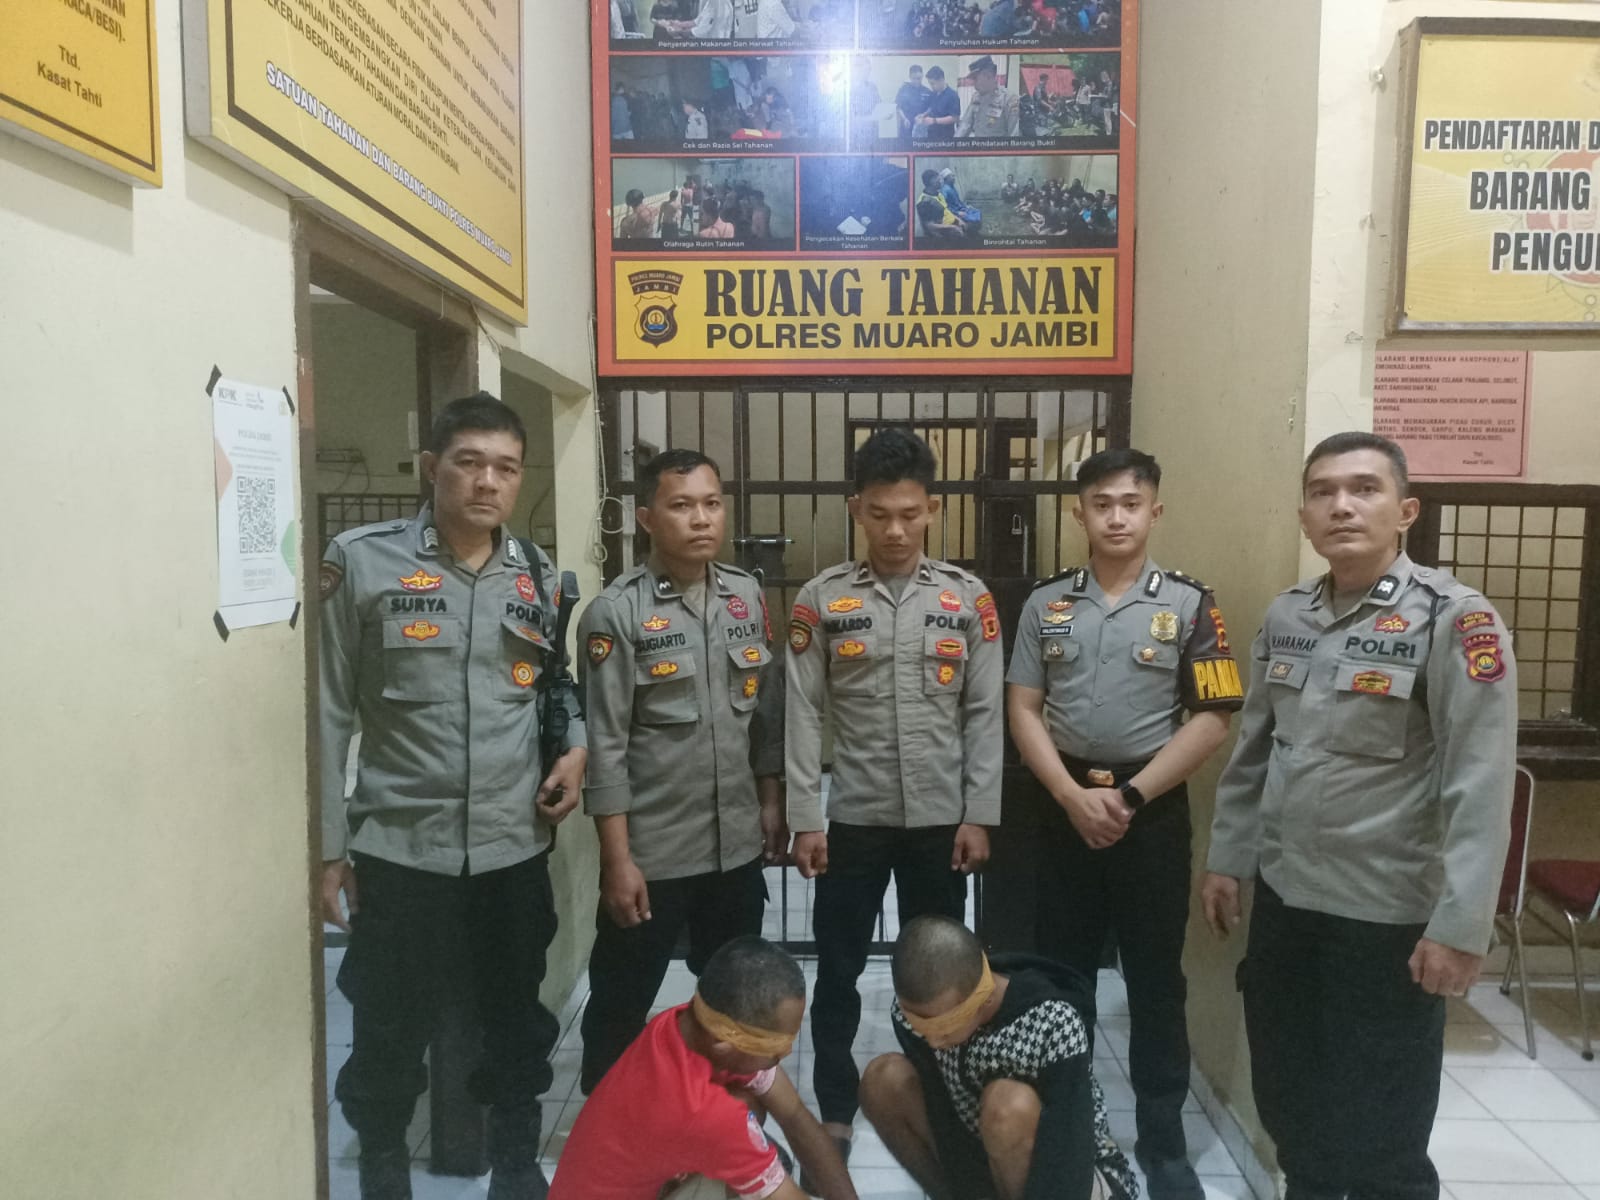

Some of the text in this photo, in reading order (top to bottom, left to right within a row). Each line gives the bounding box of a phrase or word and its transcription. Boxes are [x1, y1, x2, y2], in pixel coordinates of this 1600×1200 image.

[305, 21, 365, 91] BERDASARKAN
[37, 60, 102, 108] Kasat Tahti
[266, 58, 317, 120] SATUAN
[319, 100, 369, 159] TAHANAN
[371, 141, 391, 175] DAN
[392, 158, 425, 201] BARANG
[426, 185, 448, 218] BUKTI
[1424, 119, 1581, 150] PENDAFTARAN
[1469, 171, 1590, 210] BARANG
[703, 266, 1102, 317] RUANG TAHANAN
[706, 321, 1099, 349] POLRES MUARO JAMBI
[391, 597, 447, 613] SURYA
[727, 623, 760, 640] POLRI
[1345, 636, 1416, 659] POLRI
